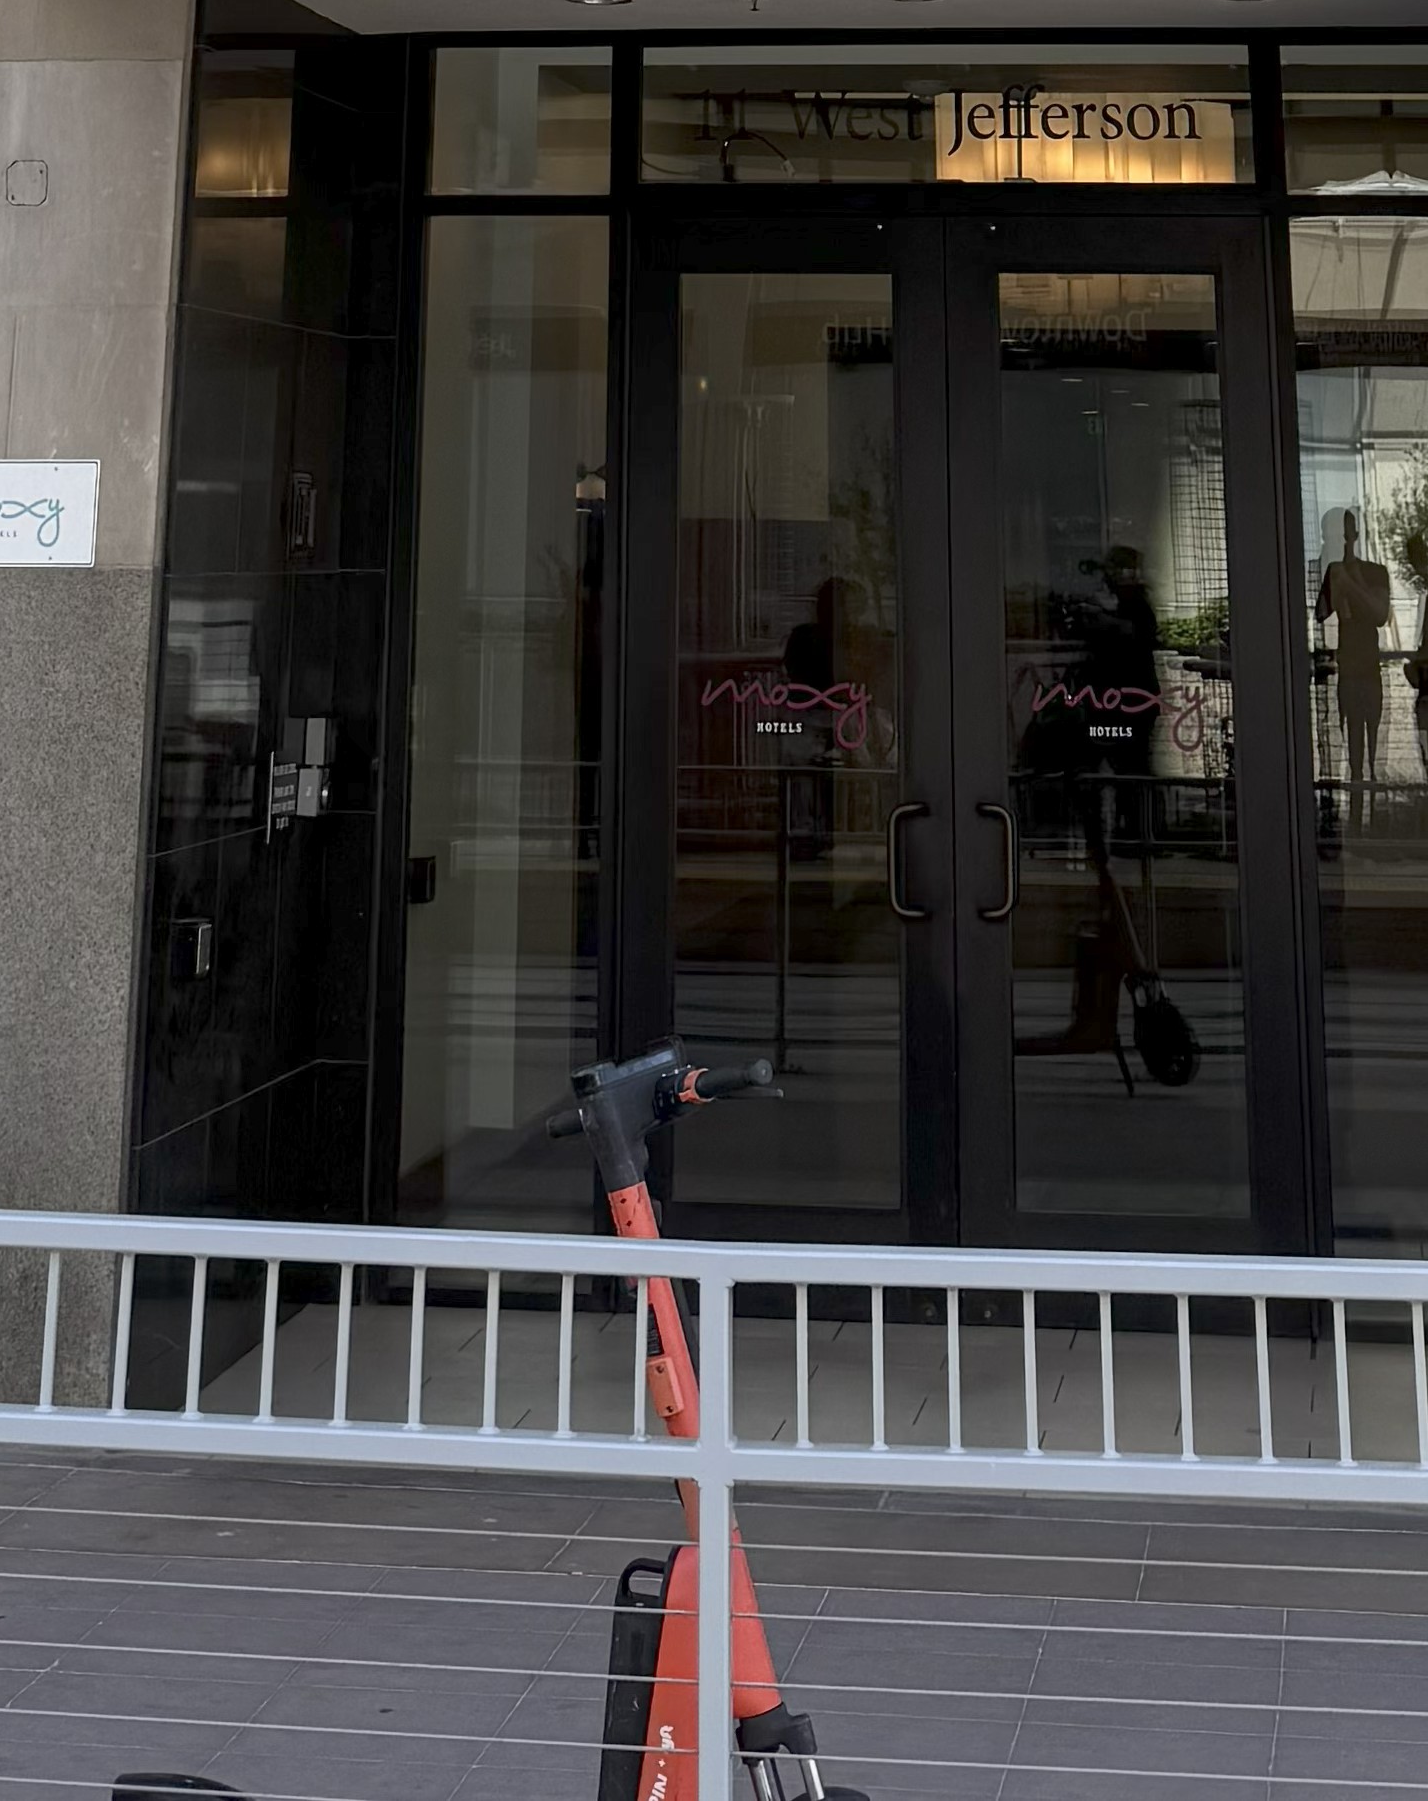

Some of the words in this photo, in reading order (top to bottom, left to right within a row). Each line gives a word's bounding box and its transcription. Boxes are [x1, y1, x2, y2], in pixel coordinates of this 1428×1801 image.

[786, 90, 923, 141] West
[947, 84, 1202, 157] Jefferson
[701, 678, 873, 751] moxy
[755, 721, 803, 734] HOTELS
[1032, 681, 1210, 751] moxy
[1088, 725, 1134, 738] HOTELS
